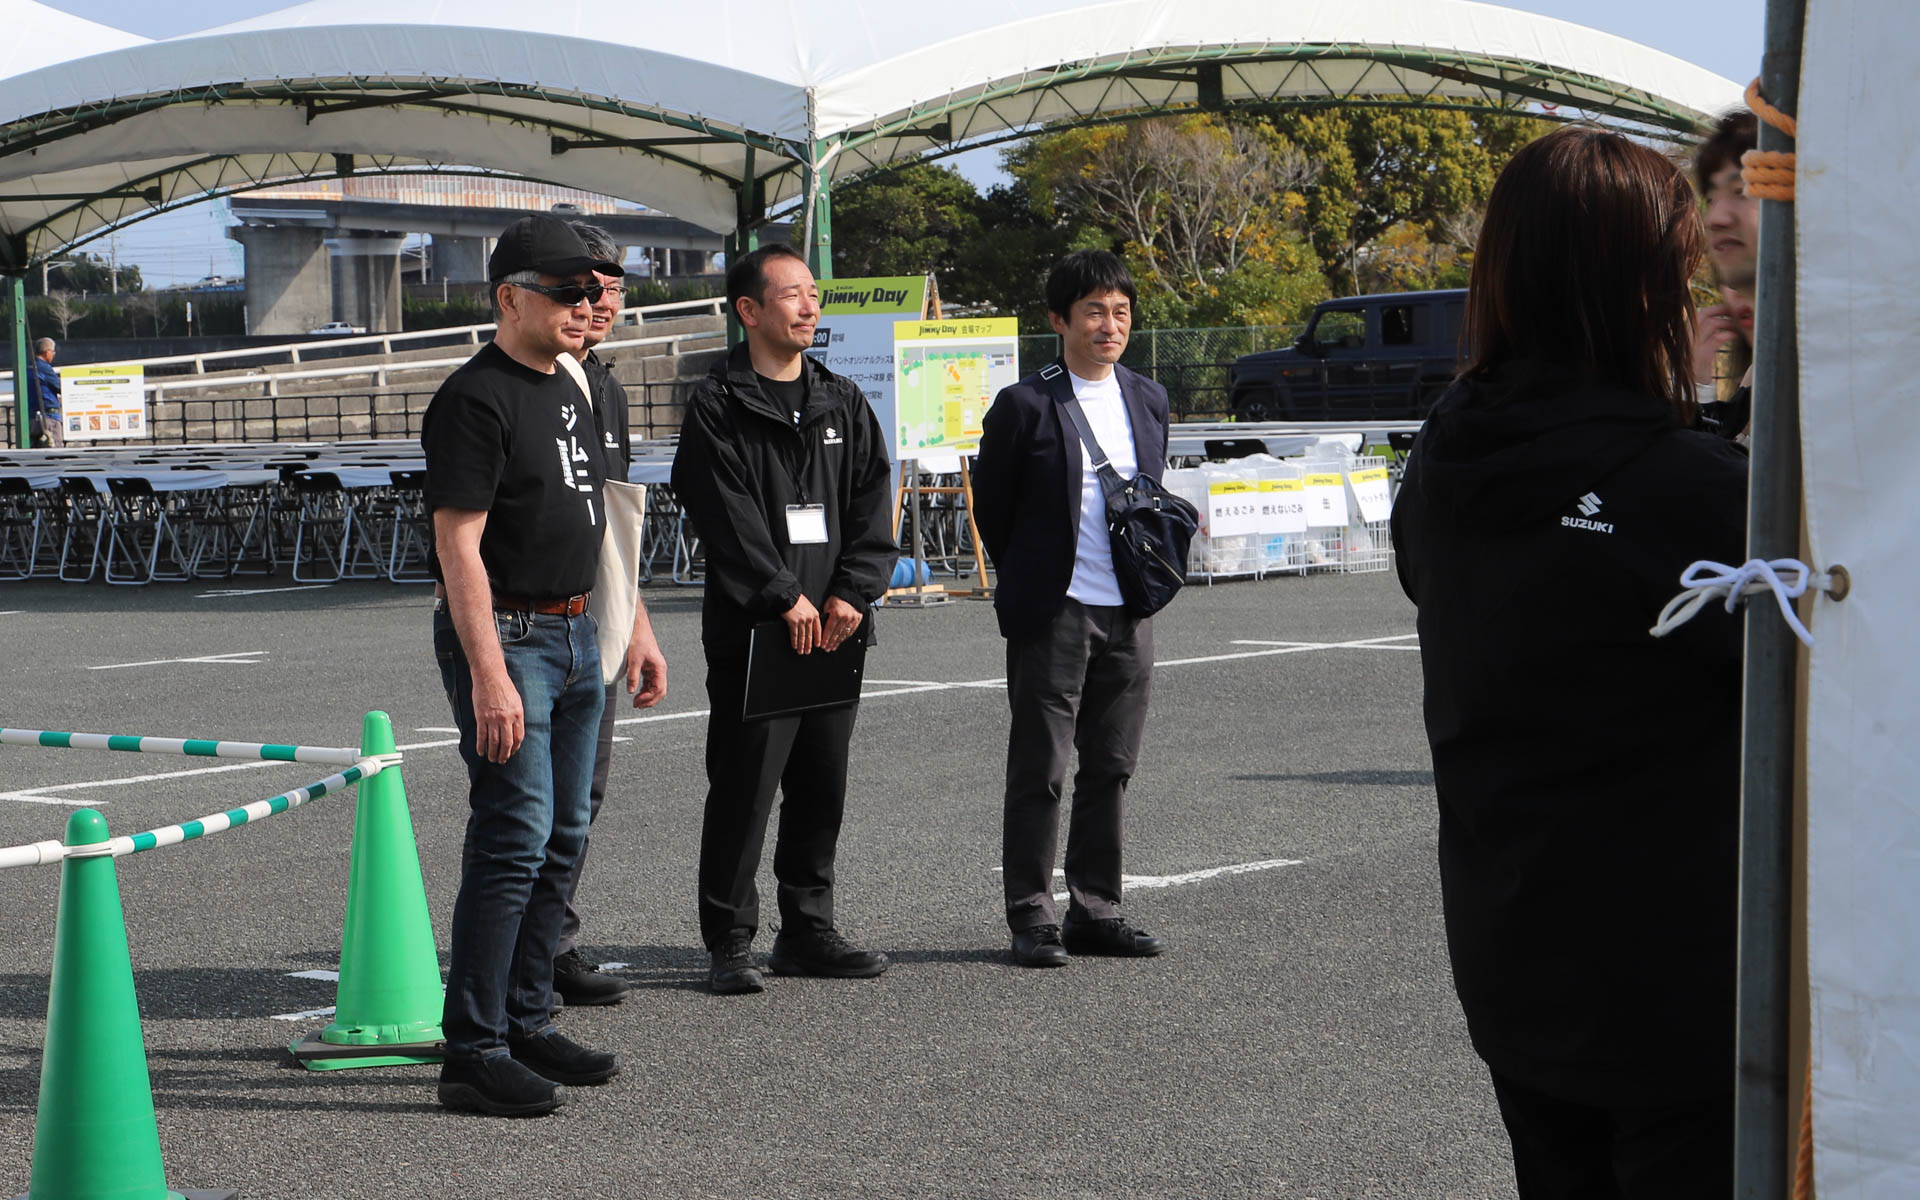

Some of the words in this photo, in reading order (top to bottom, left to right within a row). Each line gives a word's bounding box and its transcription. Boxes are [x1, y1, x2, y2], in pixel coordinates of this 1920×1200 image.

[820, 289, 871, 309] Jimny
[872, 287, 909, 306] Day
[919, 325, 941, 336] Jimny
[942, 324, 958, 335] Day
[561, 404, 596, 525] ジムニー
[1215, 505, 1256, 517] 燃えるごみ
[1262, 503, 1304, 516] 燃えないごみ
[1560, 516, 1614, 534] SUZUKI
